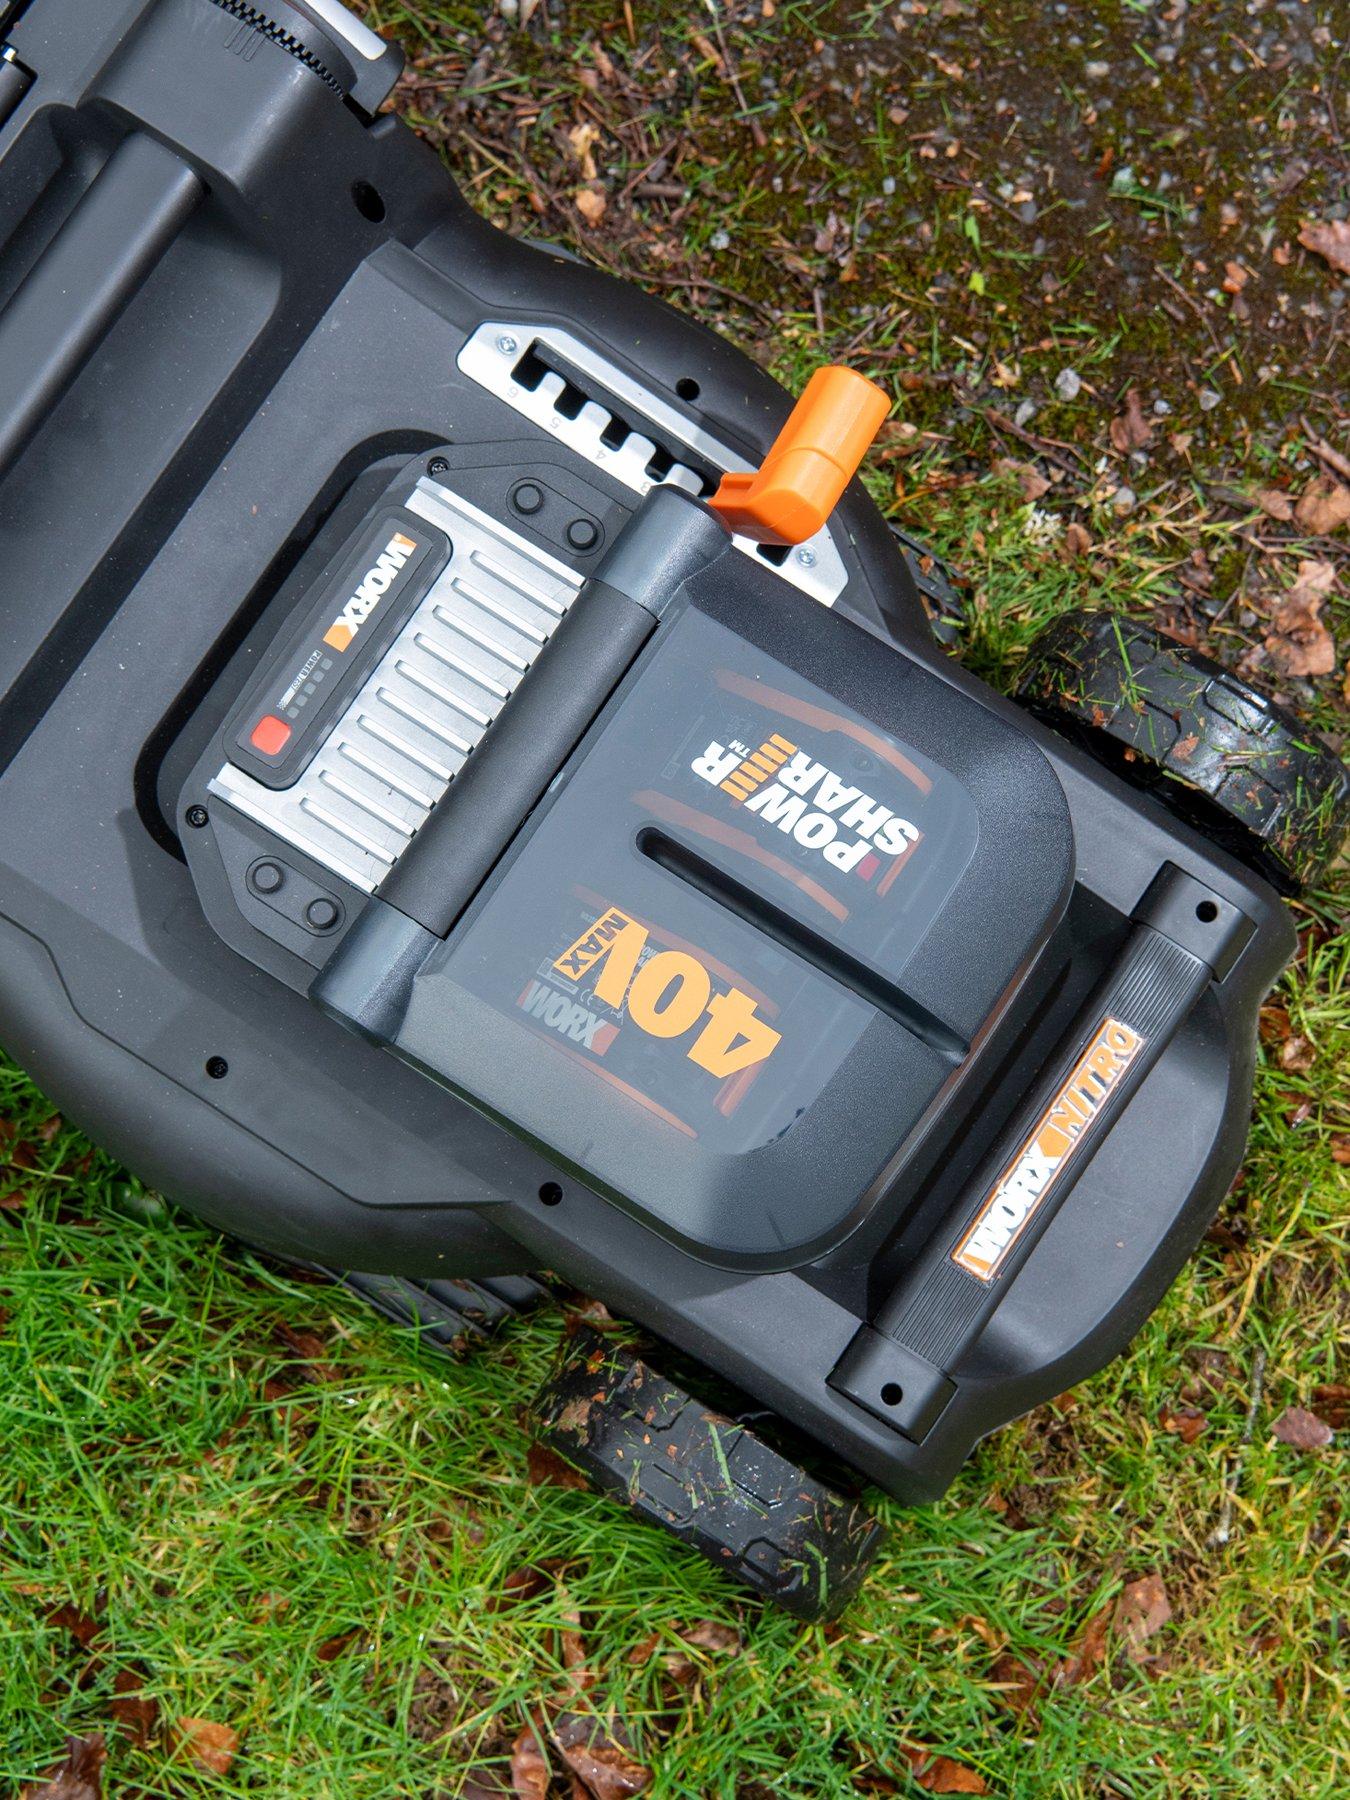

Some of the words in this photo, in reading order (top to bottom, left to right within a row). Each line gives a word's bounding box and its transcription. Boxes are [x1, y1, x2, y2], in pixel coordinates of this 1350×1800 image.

[333, 538, 416, 638] WORX
[691, 740, 873, 874] POWER
[560, 913, 629, 975] MAX
[570, 907, 782, 1078] 40V
[520, 980, 609, 1050] WORX
[963, 1140, 1061, 1264] WORX
[1050, 1023, 1137, 1139] NITRO
